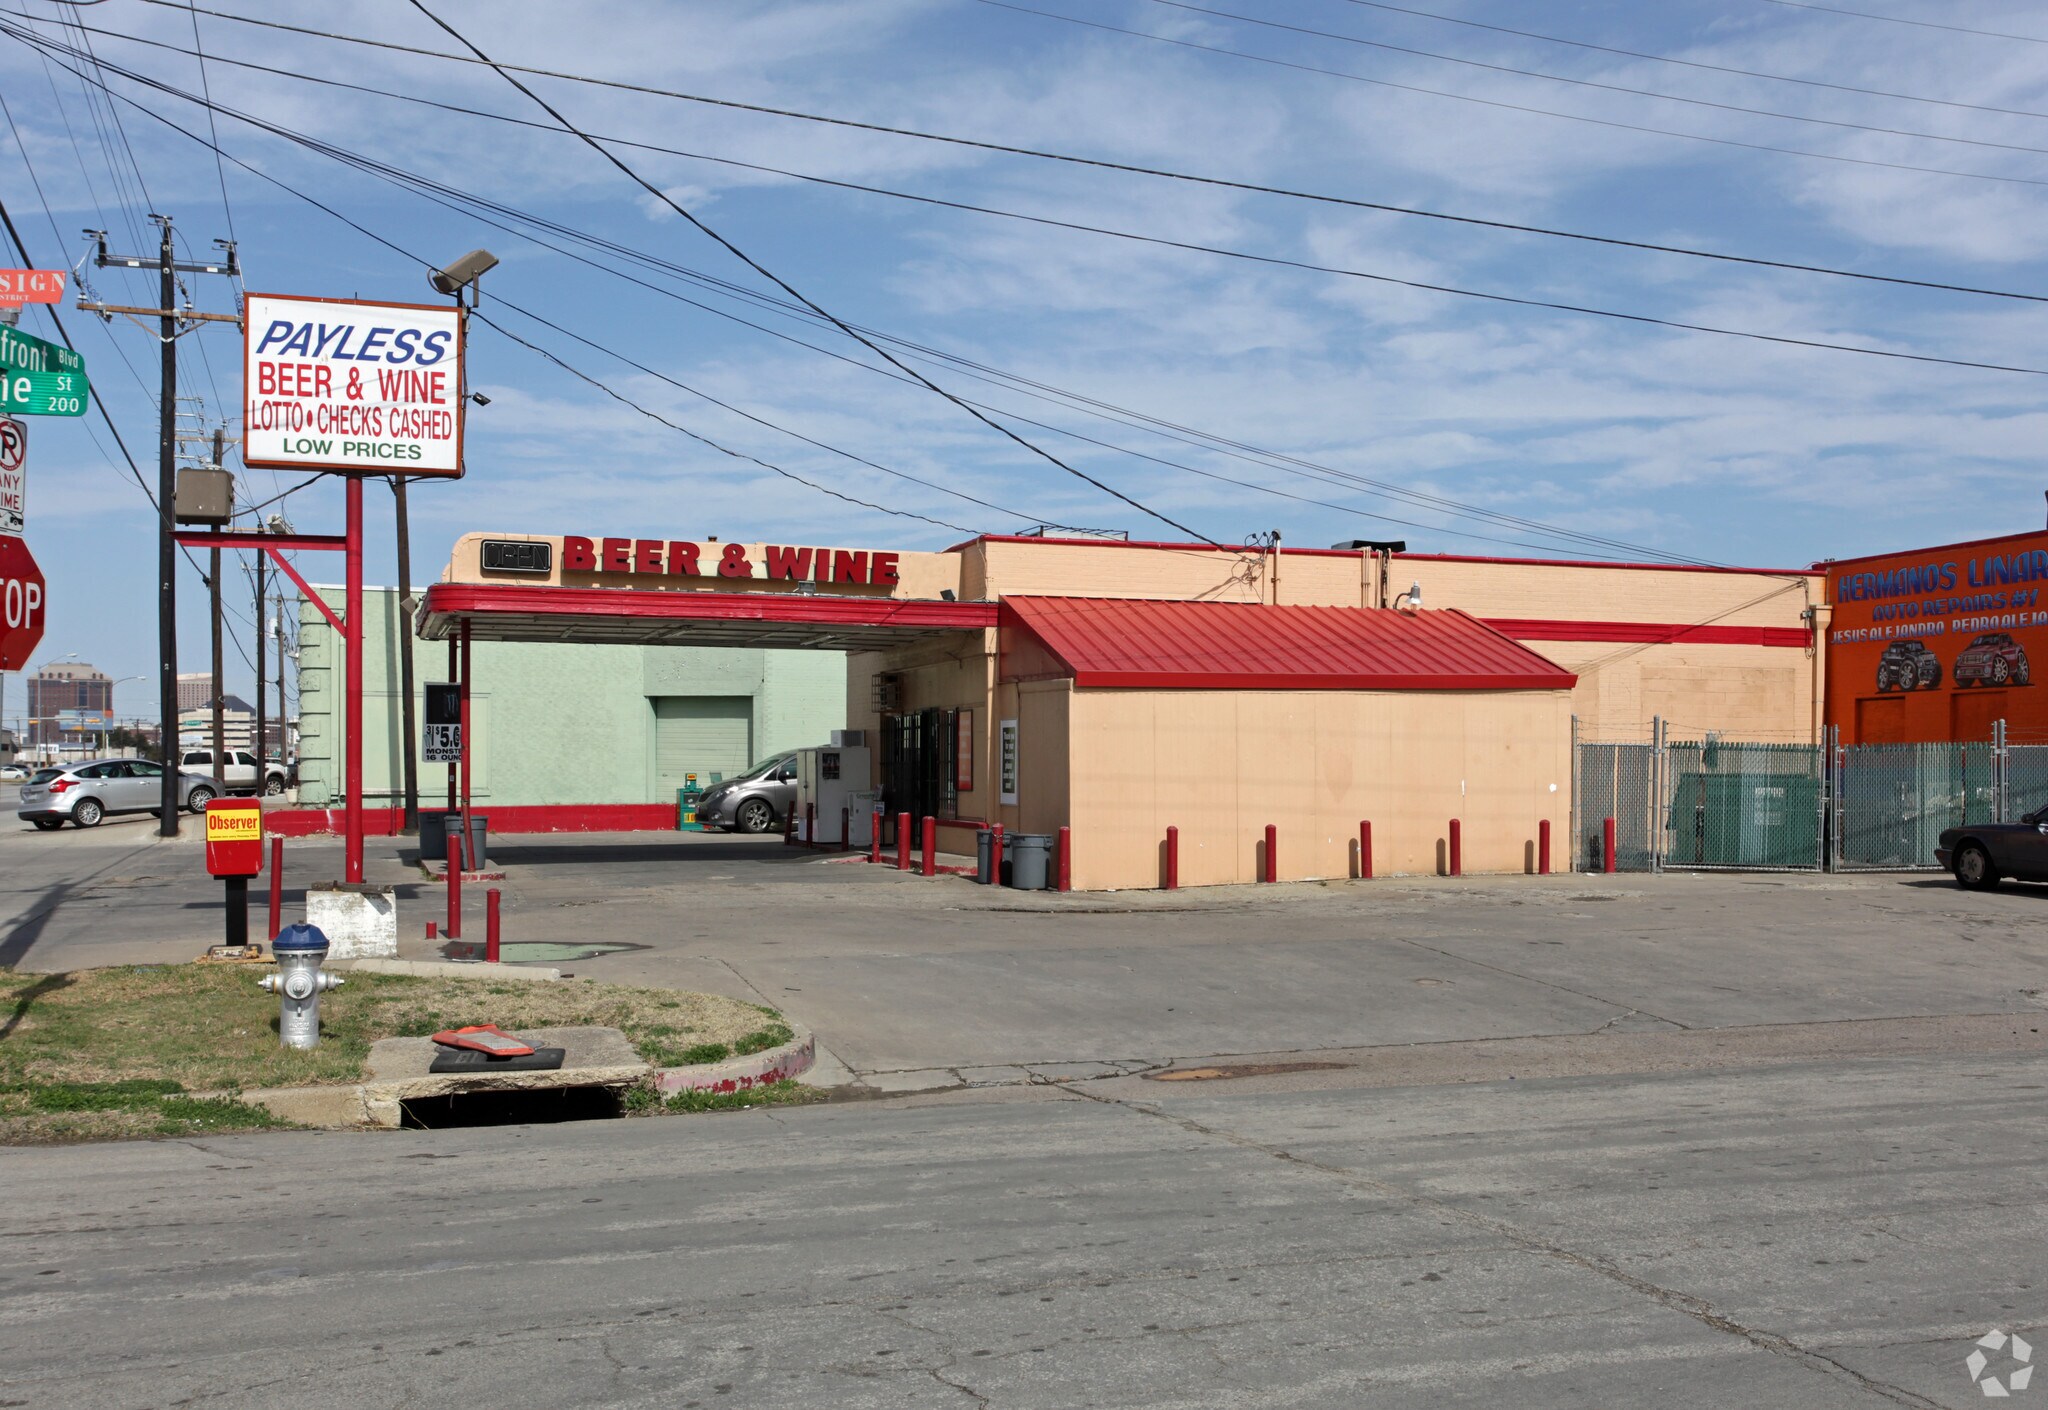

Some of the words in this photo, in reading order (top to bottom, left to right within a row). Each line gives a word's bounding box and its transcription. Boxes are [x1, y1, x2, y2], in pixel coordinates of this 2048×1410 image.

[0, 329, 48, 372] front
[58, 349, 79, 369] Blvd
[256, 320, 452, 366] PAYLESS
[57, 376, 72, 391] St
[258, 361, 332, 398] BEER
[346, 366, 364, 400] &
[378, 368, 446, 404] WINE
[48, 397, 79, 412] 200
[389, 407, 452, 440] CASHED
[283, 438, 333, 455] LOW
[343, 441, 422, 460] PRICES
[486, 544, 548, 570] OPEN
[563, 535, 701, 576] BEER
[718, 543, 753, 578] &
[766, 545, 899, 585] WINE
[1838, 562, 1959, 604] HERMANOS
[1968, 549, 2048, 587] LINAR
[1873, 602, 1919, 621] AUTO
[1923, 592, 2008, 617] REPAIRS
[2012, 588, 2039, 608] #1
[1831, 628, 1868, 645] JESUS
[1869, 620, 1945, 641] ALEJANDRO
[1952, 615, 1999, 633] PEDRO
[209, 814, 258, 830] Observer
